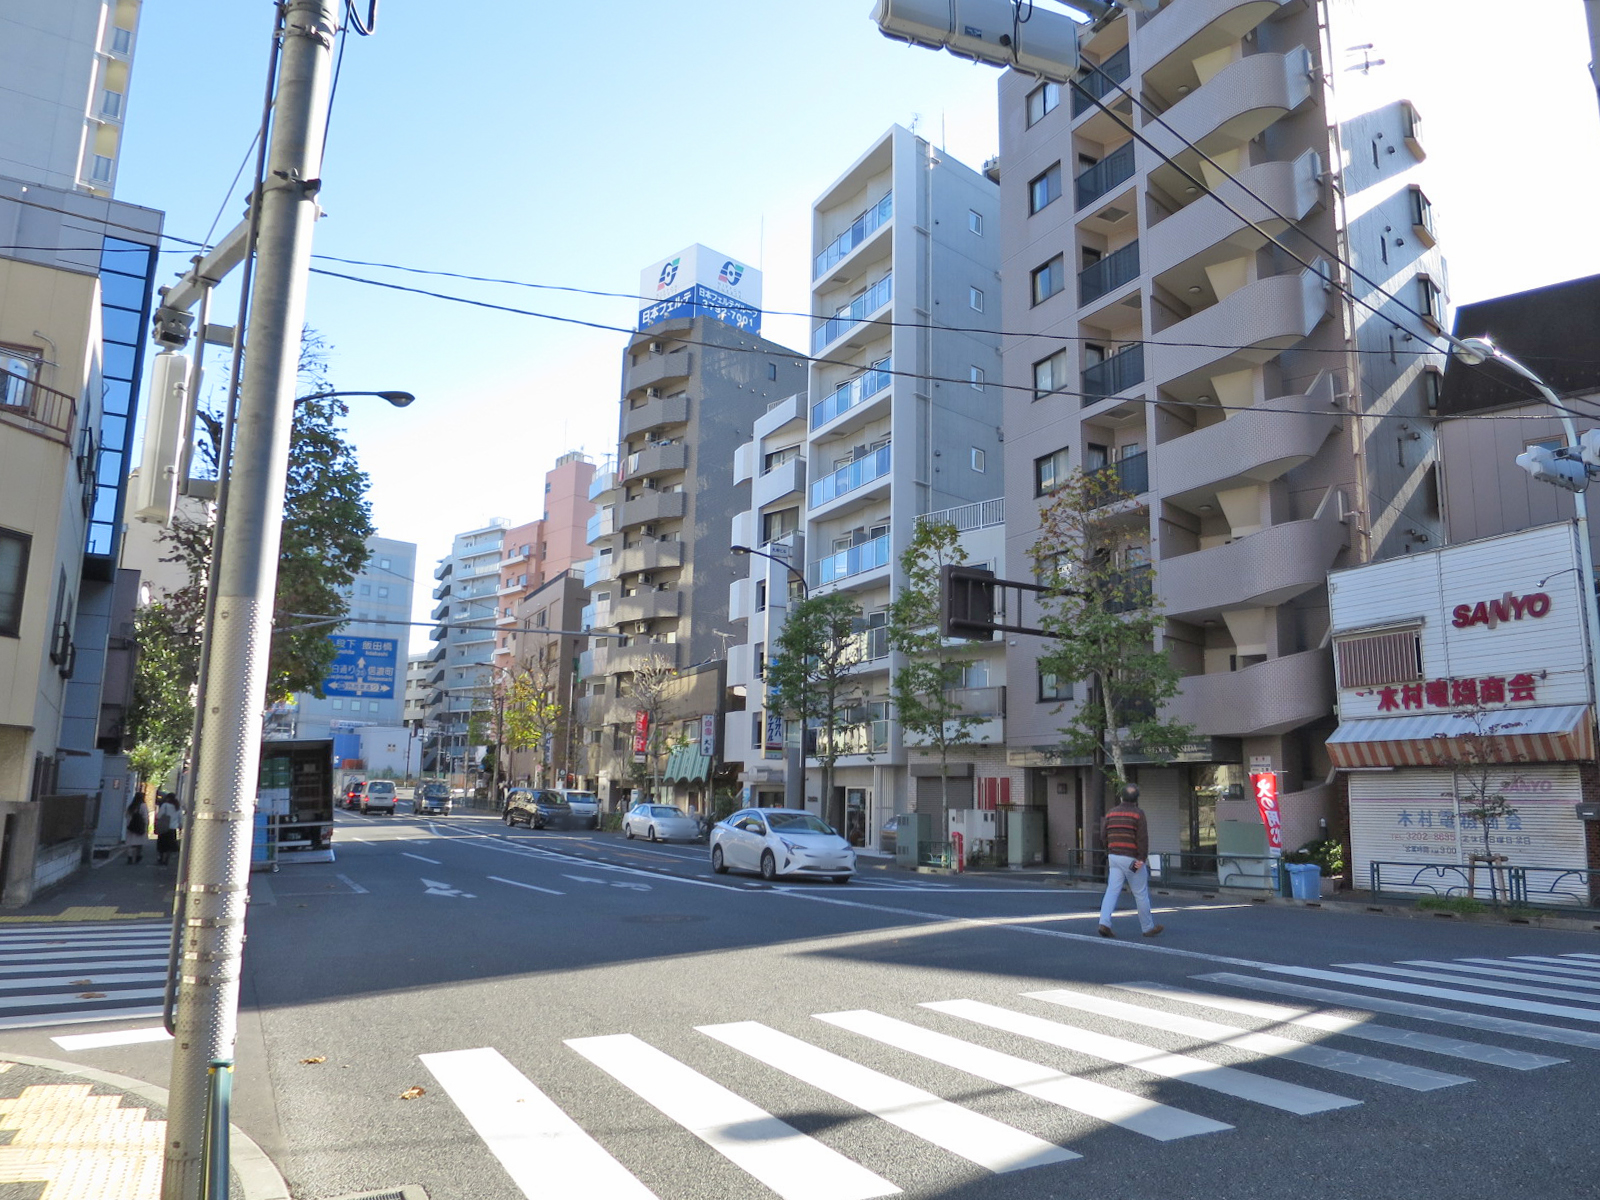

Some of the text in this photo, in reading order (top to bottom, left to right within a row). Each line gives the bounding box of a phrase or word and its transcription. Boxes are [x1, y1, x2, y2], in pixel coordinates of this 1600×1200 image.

[702, 299, 753, 326] 3792-7001
[1452, 592, 1551, 629] SANYO
[362, 641, 392, 651] 飯田橋
[1377, 674, 1536, 712] 木村電機商会
[1256, 778, 1280, 844] 火の用心
